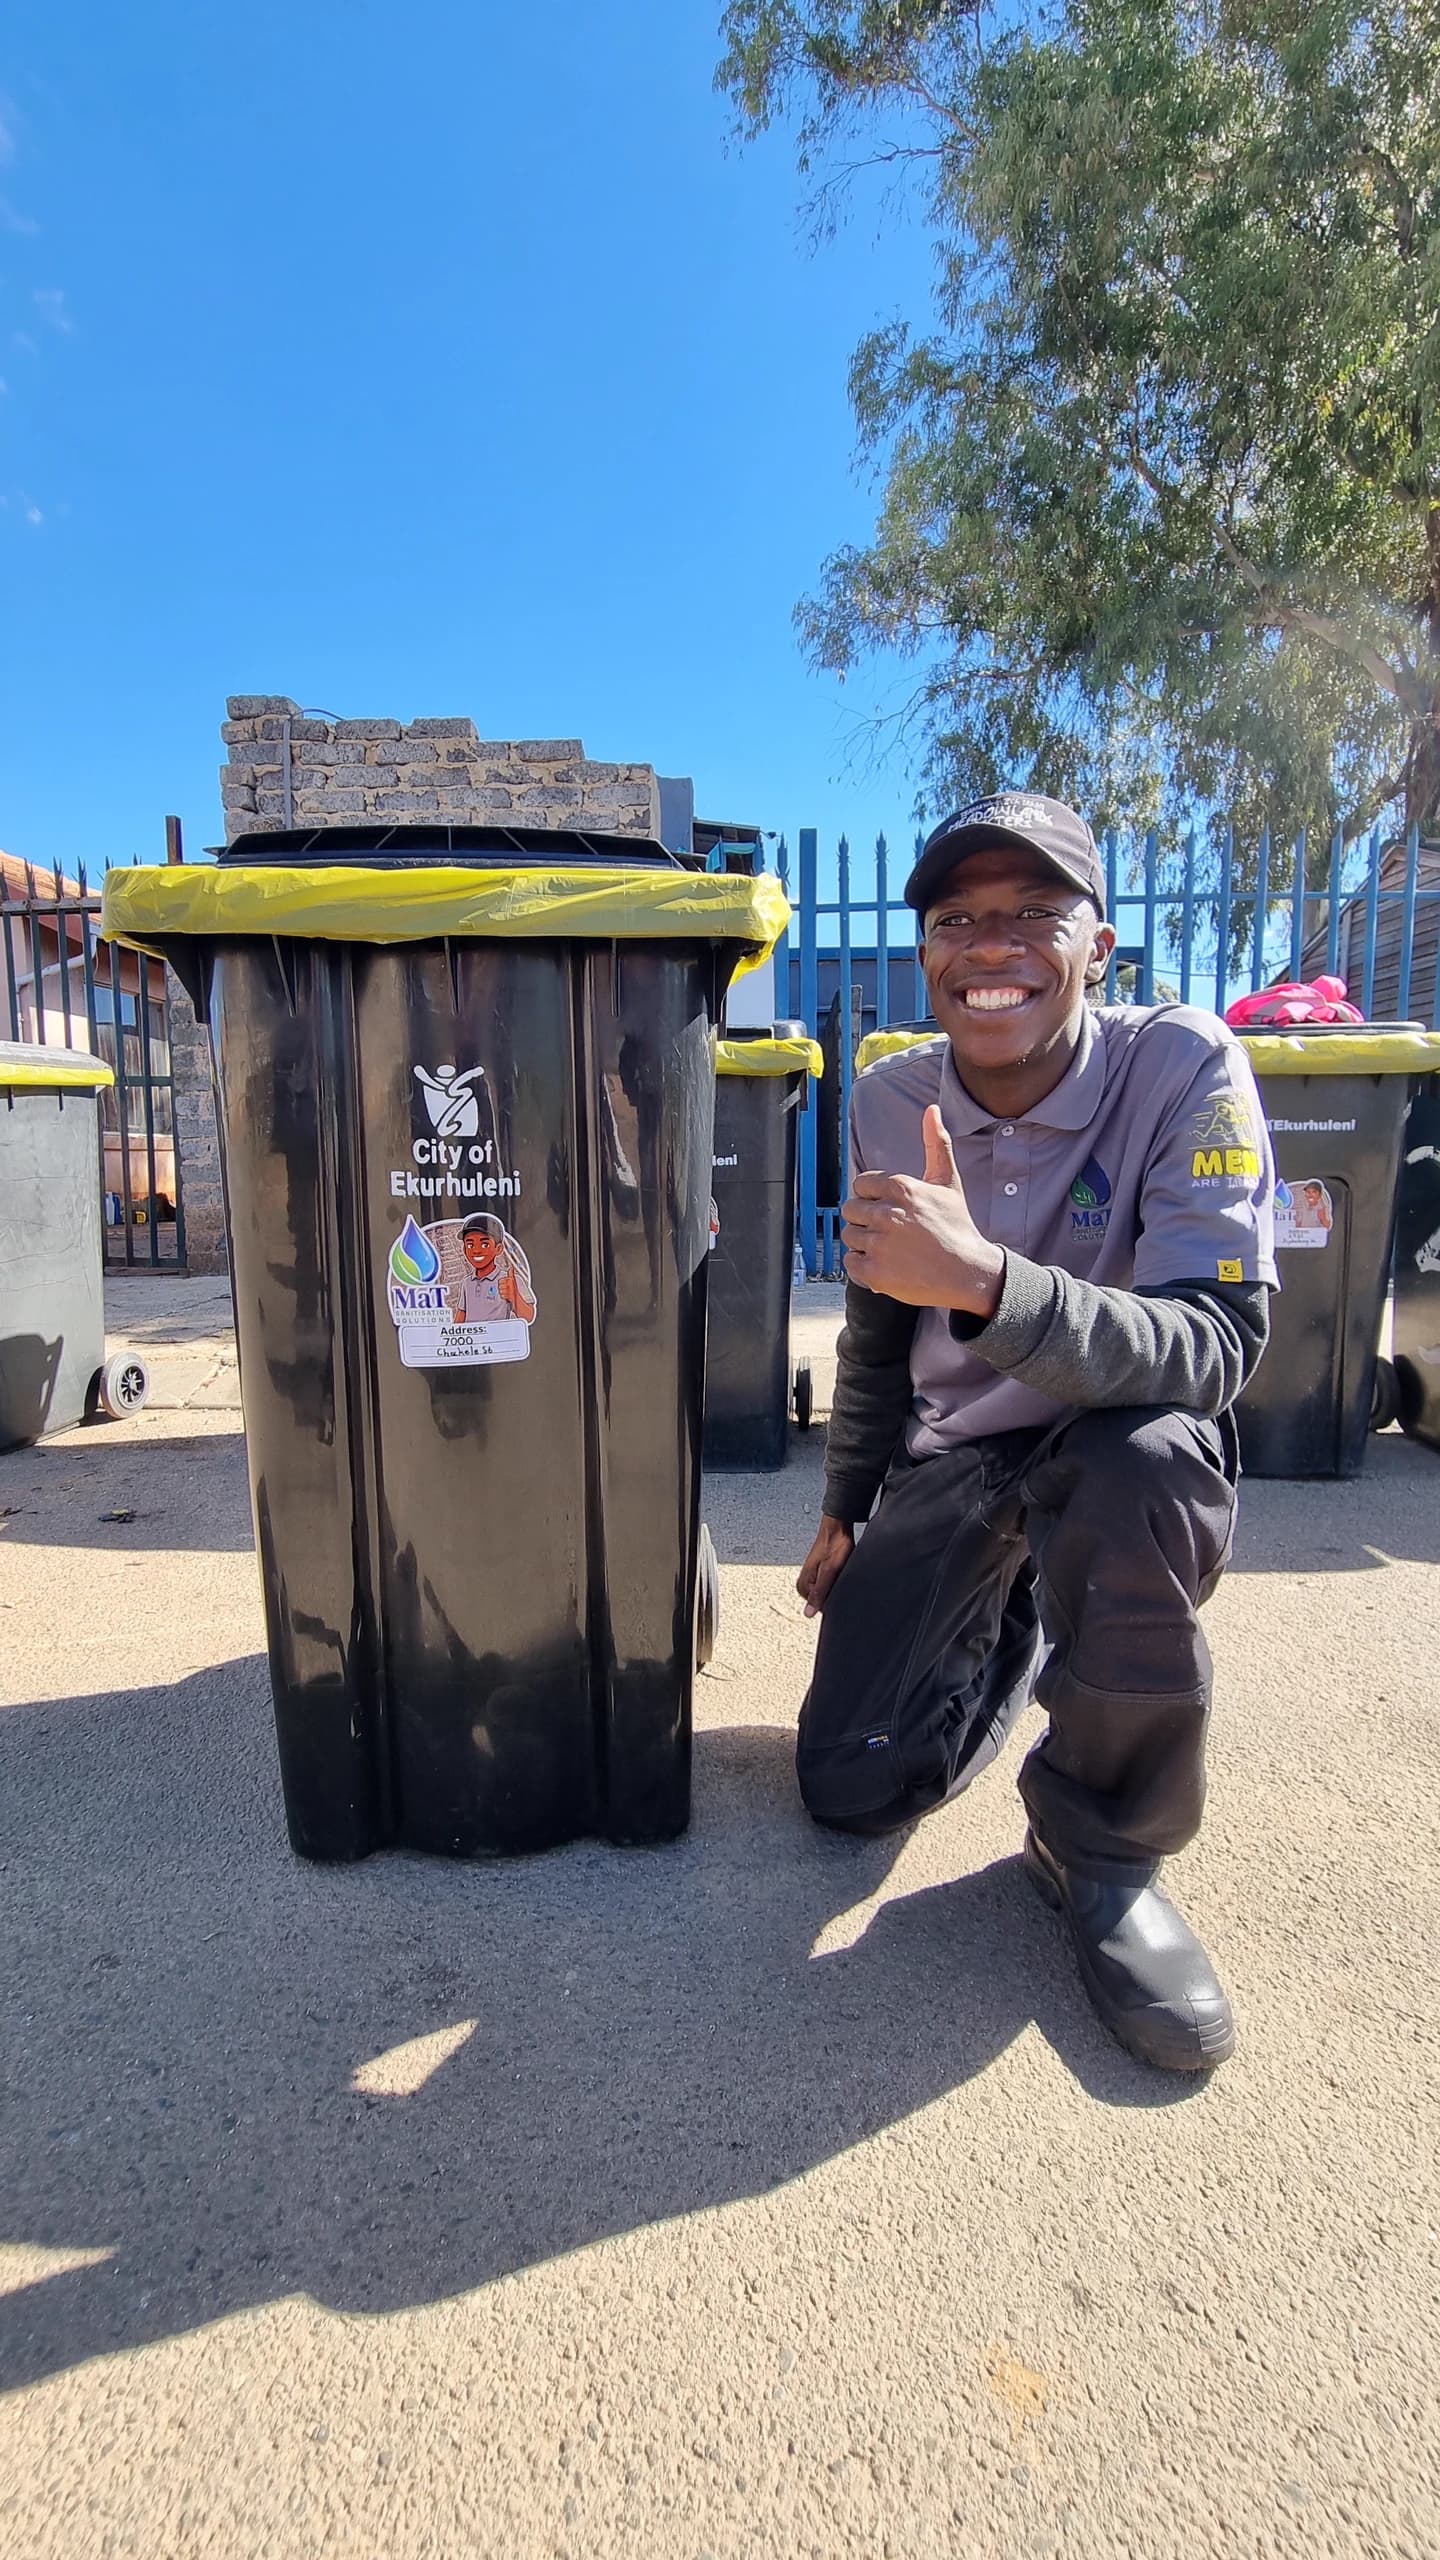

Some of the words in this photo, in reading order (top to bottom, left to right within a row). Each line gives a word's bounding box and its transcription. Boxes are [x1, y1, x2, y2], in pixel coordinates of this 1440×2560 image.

[412, 1138, 463, 1170] City
[468, 1139, 493, 1164] of
[1191, 1147, 1259, 1178] MEN
[390, 1170, 521, 1197] Ekurhuleni
[1191, 1177, 1221, 1188] ARE
[393, 1287, 448, 1309] MaT
[395, 1309, 451, 1317] SANITISATION
[440, 1325, 487, 1336] Address:
[443, 1336, 473, 1346] 7000
